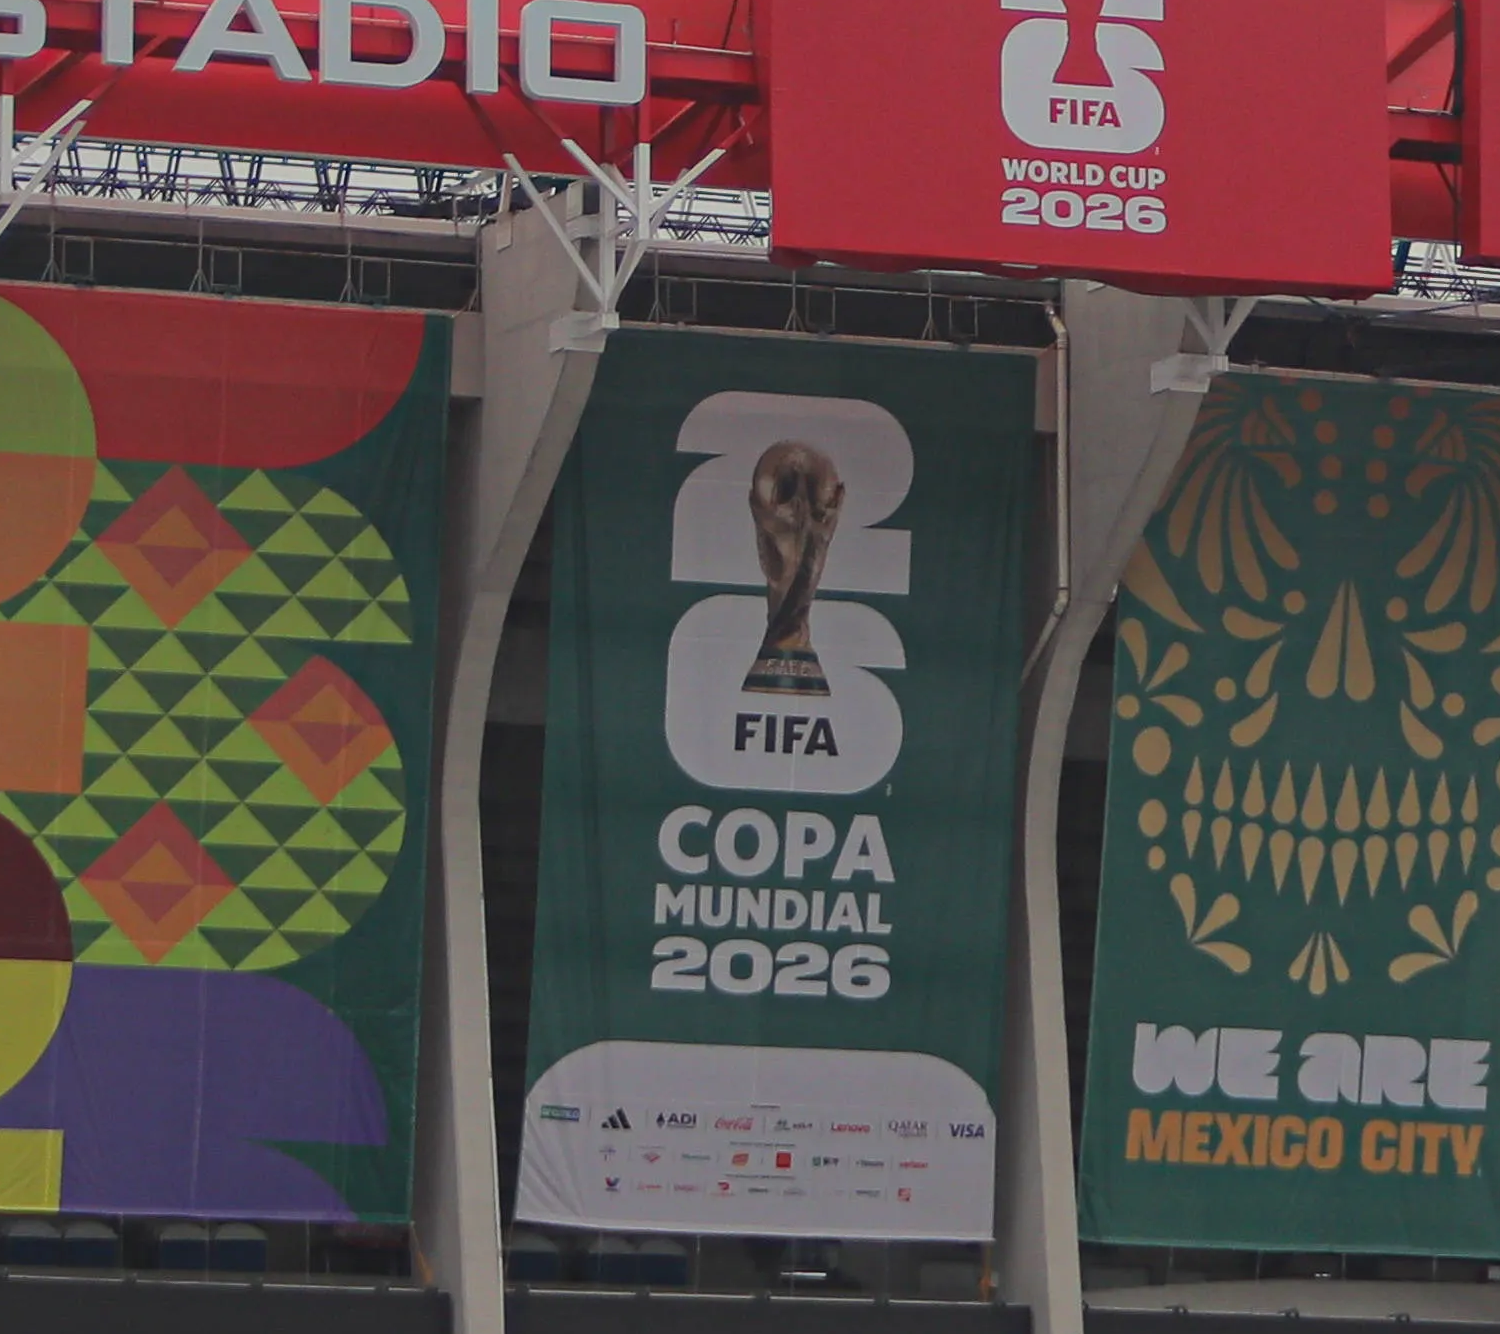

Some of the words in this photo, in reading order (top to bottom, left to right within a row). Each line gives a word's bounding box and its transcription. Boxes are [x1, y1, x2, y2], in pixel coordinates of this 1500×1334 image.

[1049, 97, 1122, 128] FIFA
[1001, 157, 1104, 187] WORLD
[1109, 165, 1166, 190] CUP
[1001, 187, 1167, 234] 2026
[734, 712, 839, 757] FIFA
[658, 804, 896, 883] COPA
[653, 882, 893, 935] MUNDIAL
[650, 935, 892, 999] 2026
[1132, 1021, 1283, 1100] WE
[667, 1113, 697, 1126] ADI
[831, 1122, 871, 1134] Lenovo
[949, 1123, 985, 1138] VISA
[1125, 1108, 1344, 1170] MEXICO
[1360, 1119, 1485, 1177] CITY
